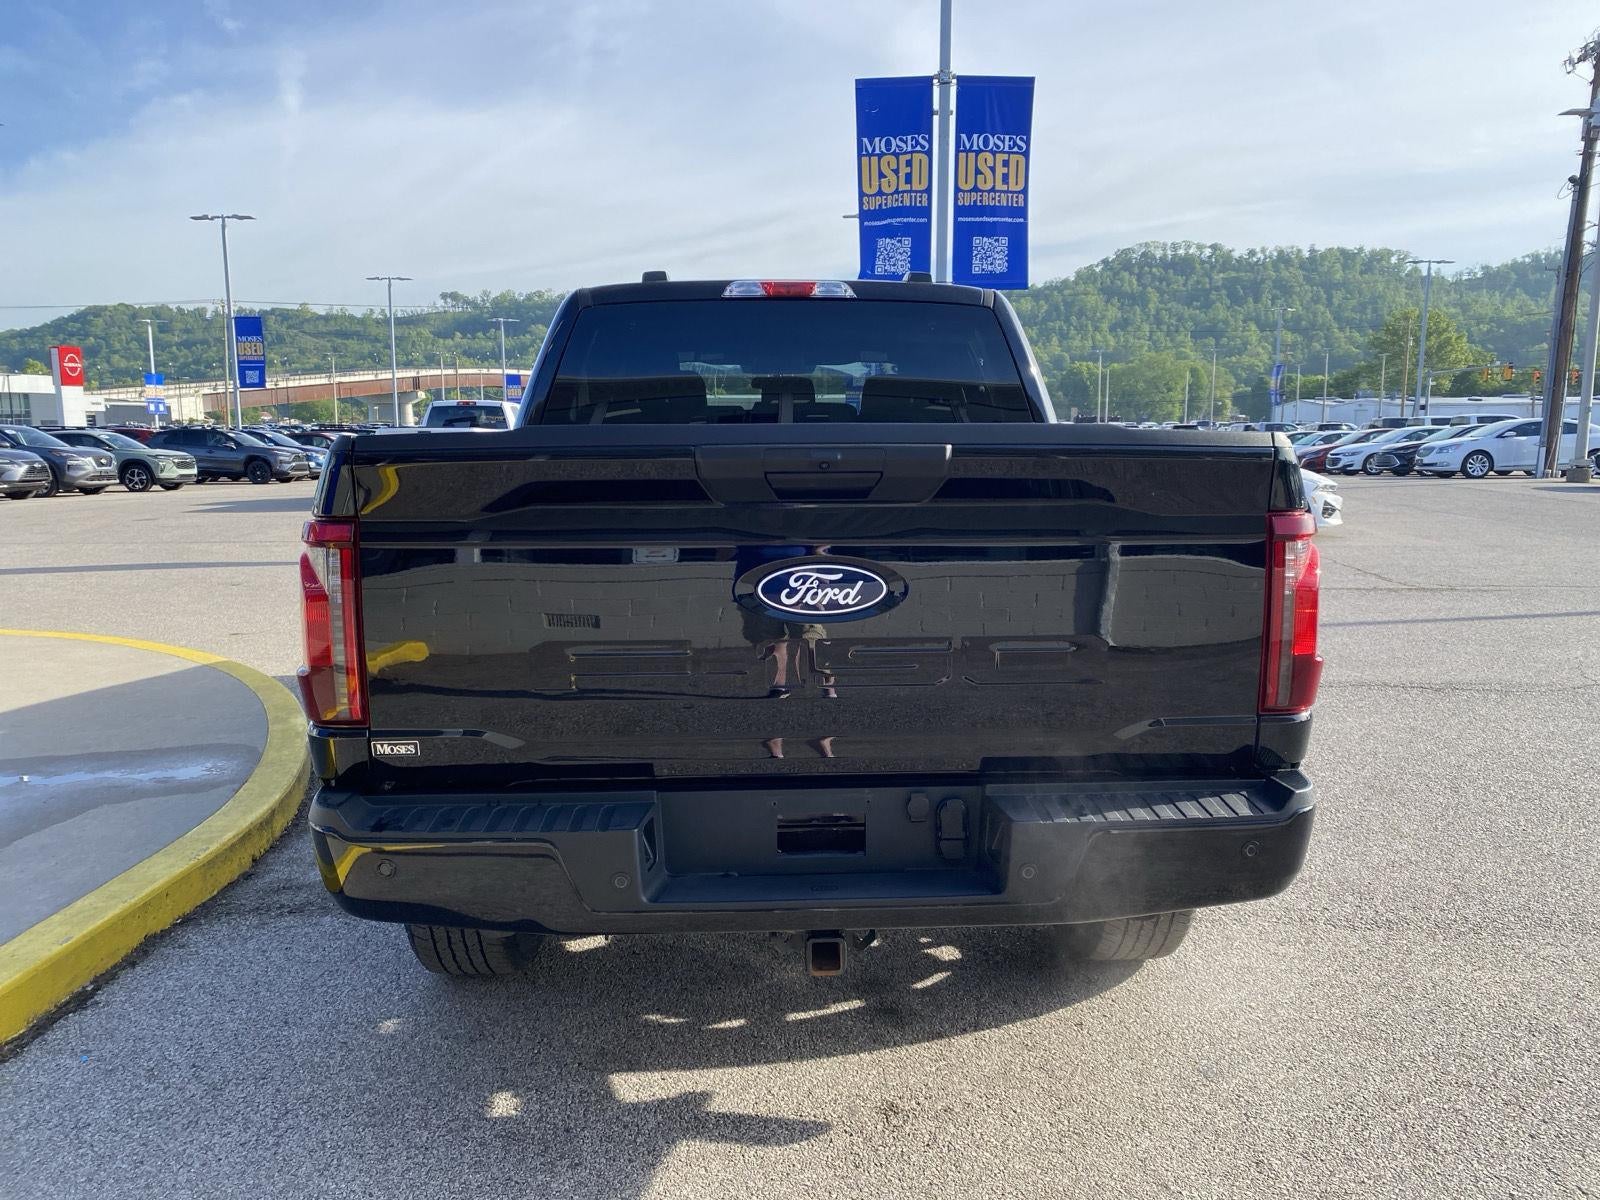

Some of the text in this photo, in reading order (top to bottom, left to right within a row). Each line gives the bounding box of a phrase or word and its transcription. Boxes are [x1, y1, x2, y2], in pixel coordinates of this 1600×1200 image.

[861, 134, 929, 154] MOSES
[960, 133, 1027, 152] MOSES
[861, 153, 929, 194] USED
[958, 152, 1025, 191] USED
[862, 193, 928, 210] SUPERCENTER
[958, 192, 1025, 207] SUPERCENTER
[237, 342, 264, 356] USED
[780, 571, 863, 605] Ford
[376, 744, 416, 755] MOSES
